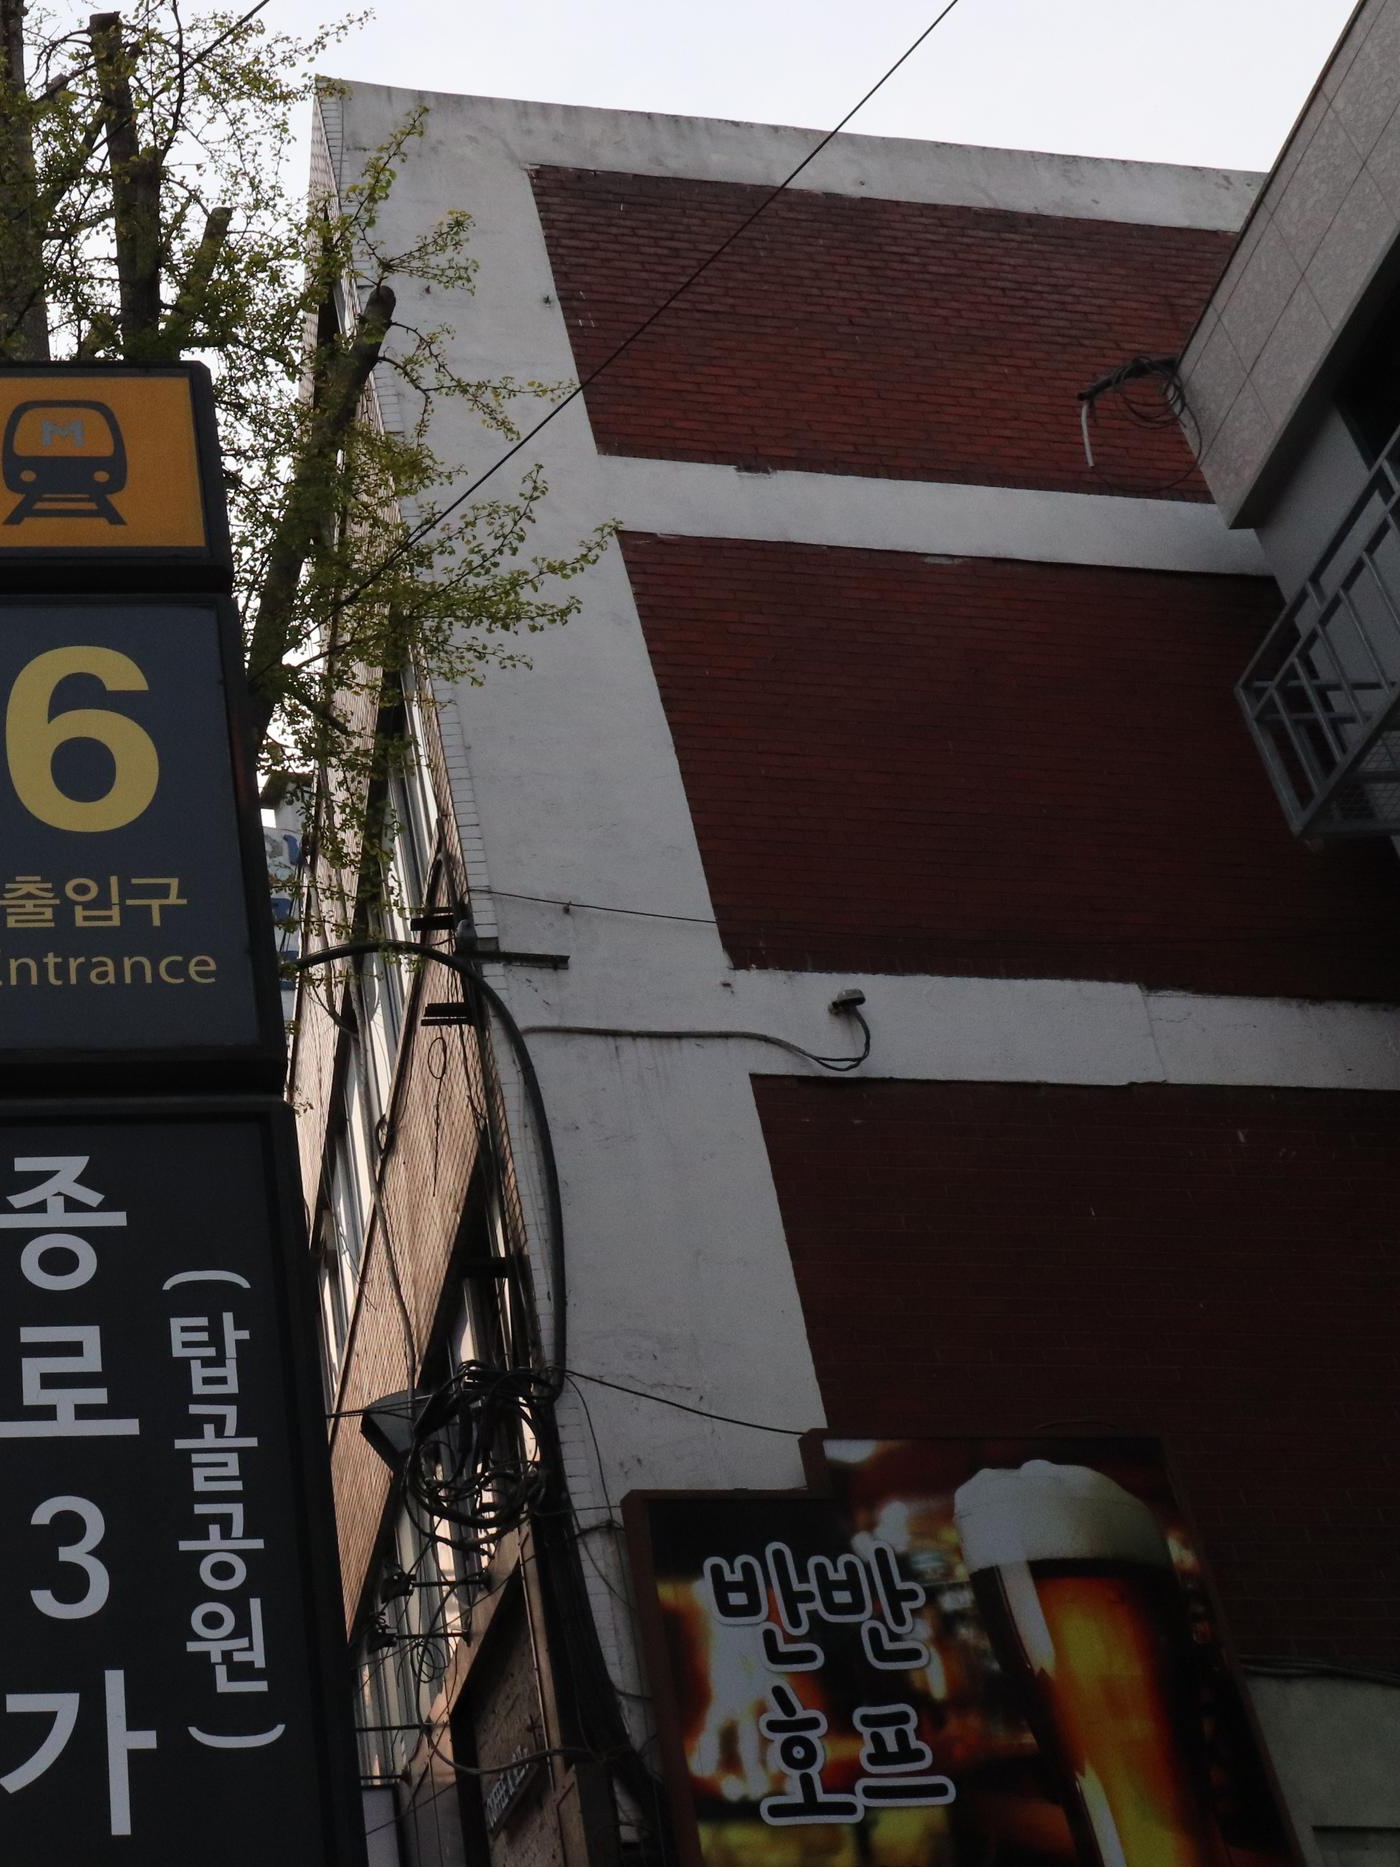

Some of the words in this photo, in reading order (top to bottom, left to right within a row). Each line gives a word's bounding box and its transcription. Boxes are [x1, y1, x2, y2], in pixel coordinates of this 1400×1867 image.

[6, 645, 159, 832] 6
[162, 1270, 286, 1748] (탑골공원)
[703, 1542, 930, 1672] 반반
[759, 1678, 956, 1826] 호프
